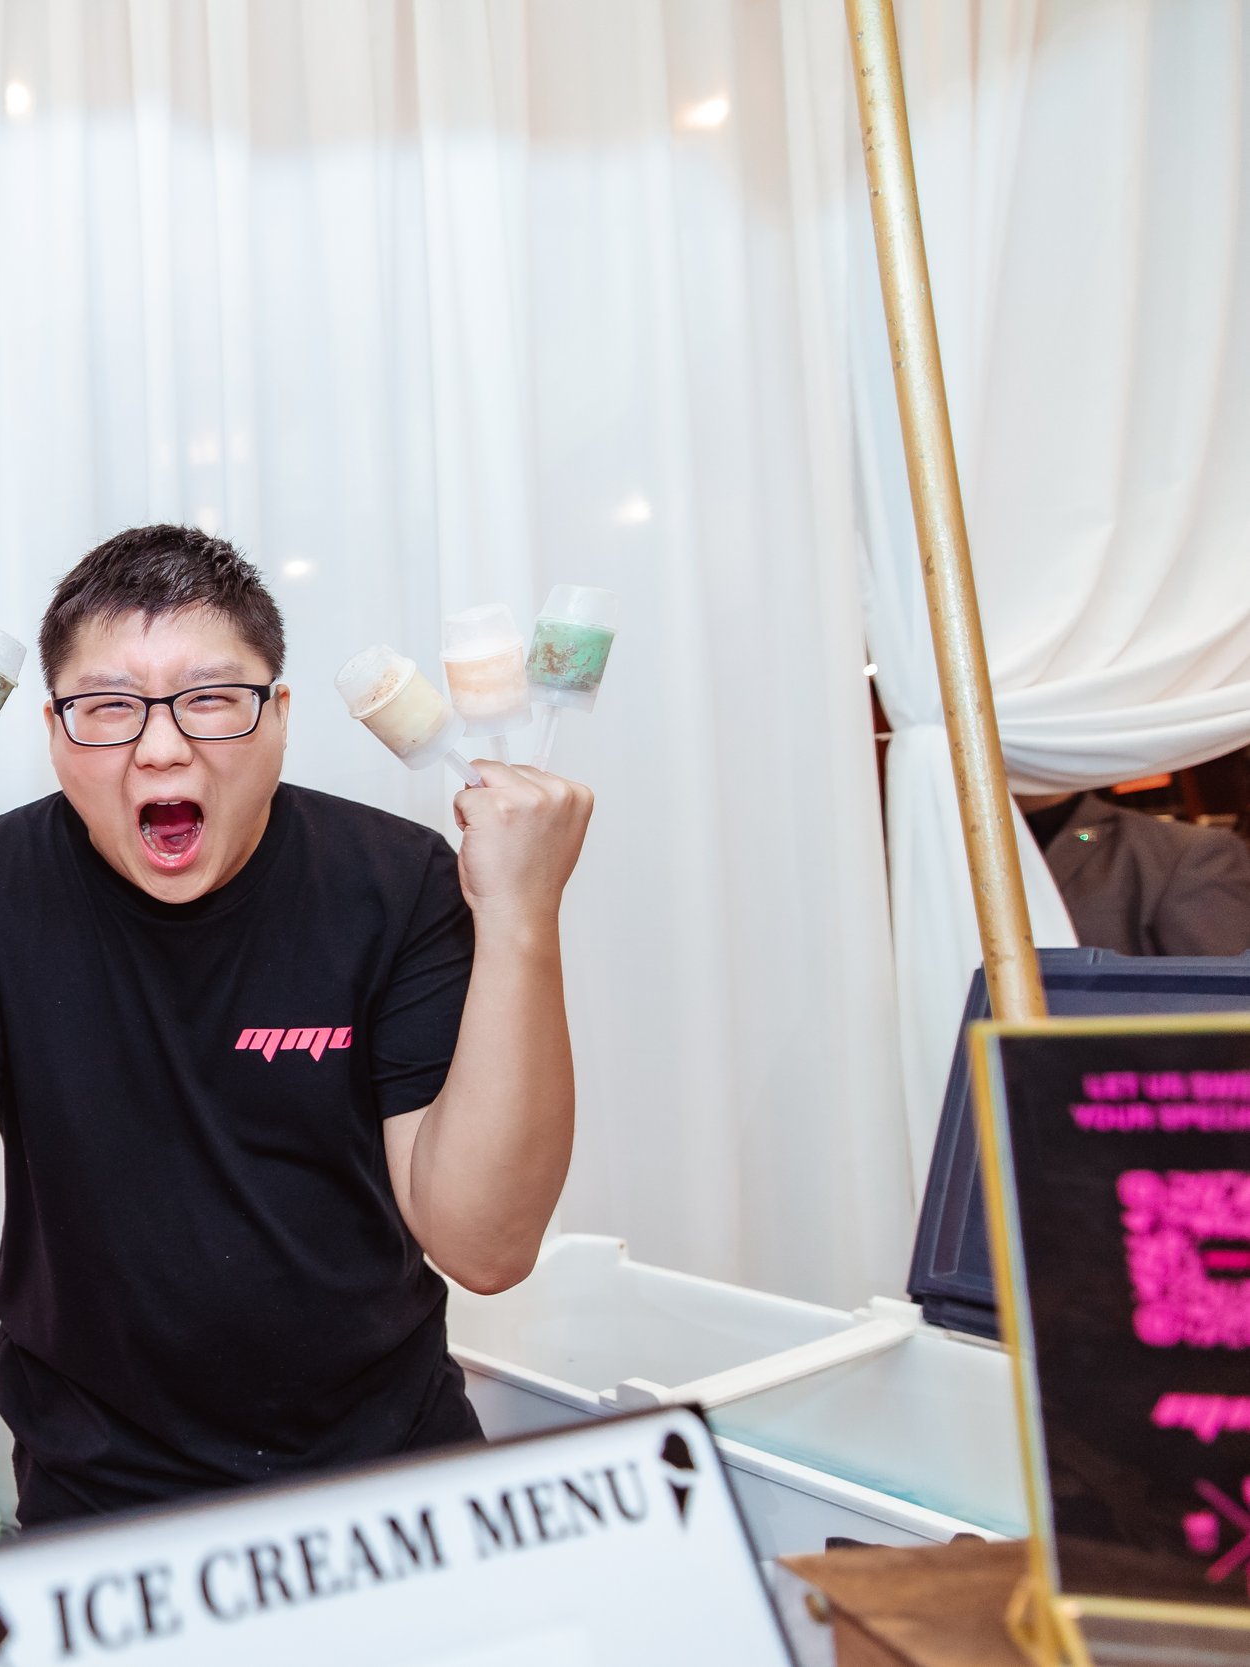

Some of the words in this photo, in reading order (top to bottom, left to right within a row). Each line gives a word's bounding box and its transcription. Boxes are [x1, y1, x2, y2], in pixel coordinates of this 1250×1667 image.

[51, 1561, 182, 1659] ICE
[198, 1507, 448, 1623] CREAM
[463, 1459, 650, 1562] MENU
